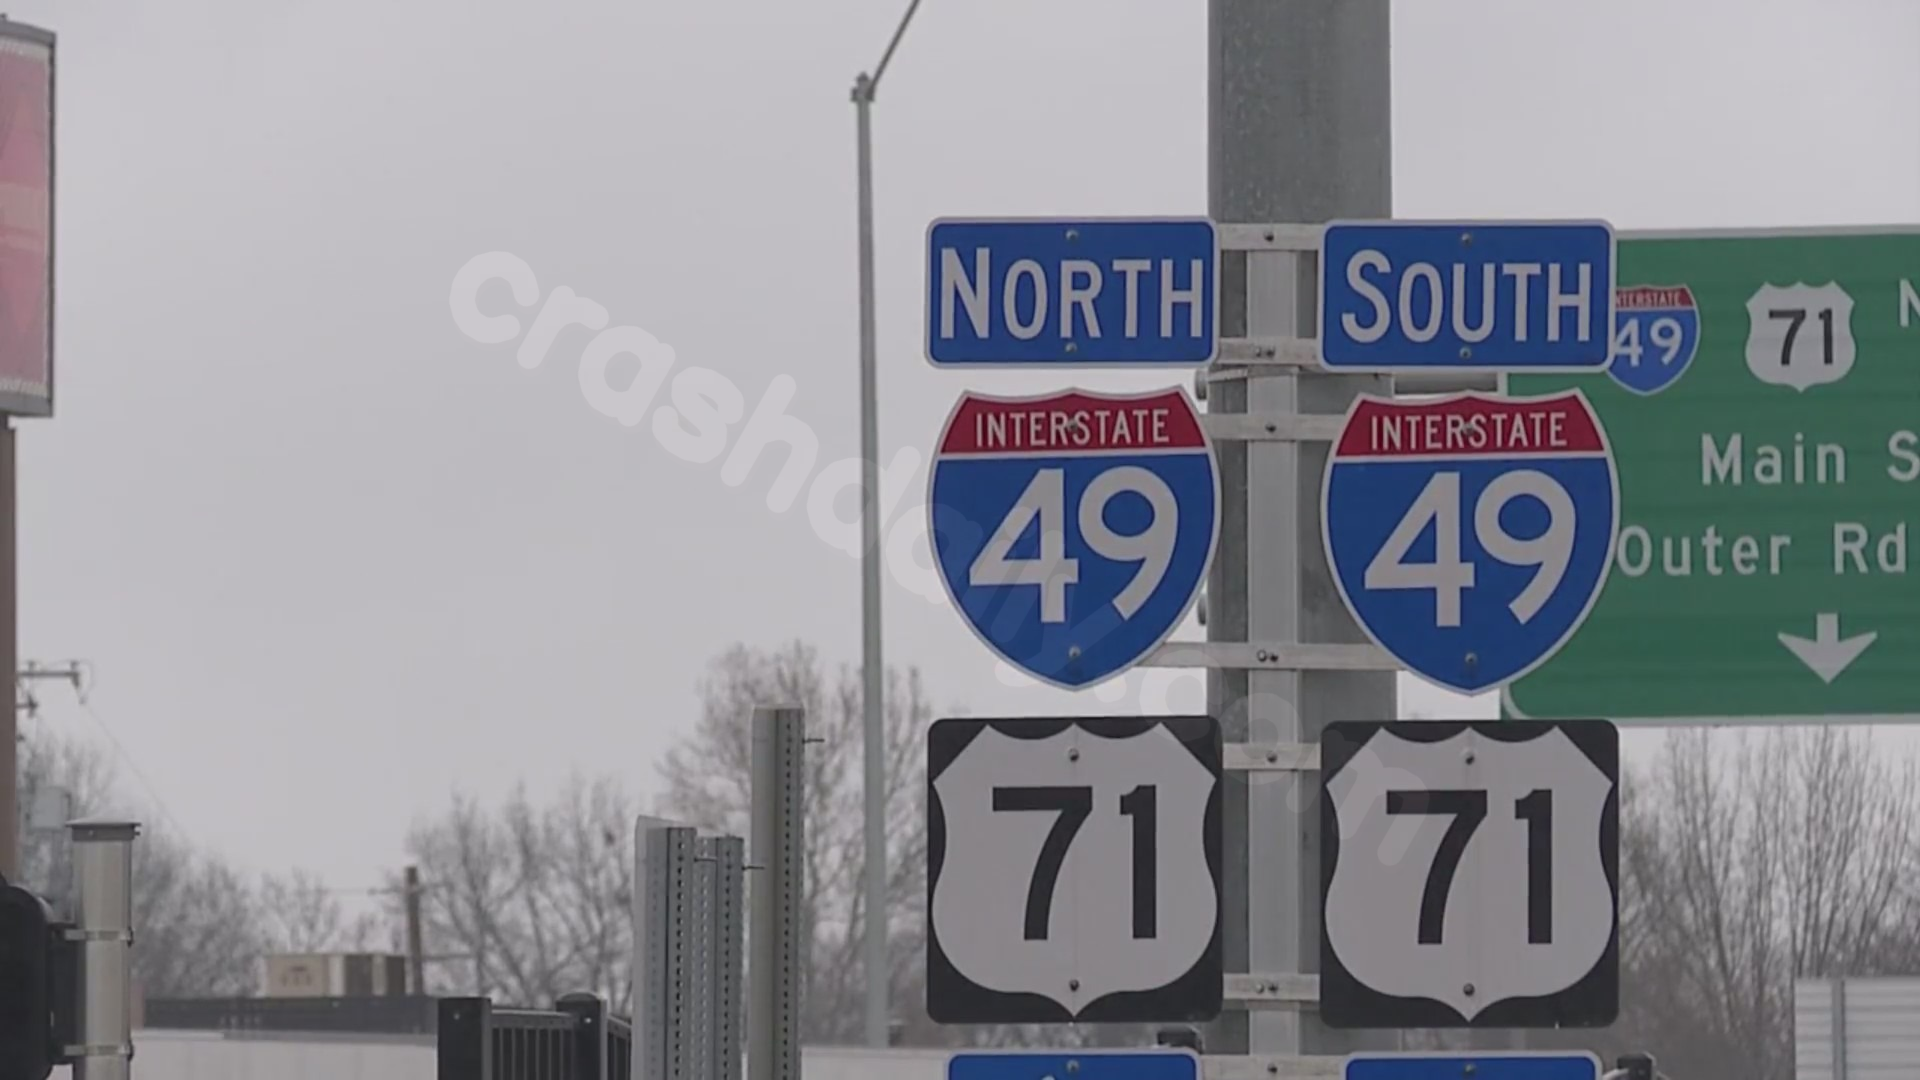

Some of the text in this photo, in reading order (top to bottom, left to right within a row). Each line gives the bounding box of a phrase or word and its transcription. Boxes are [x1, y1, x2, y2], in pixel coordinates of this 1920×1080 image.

[941, 247, 1204, 340] NORTH
[1342, 249, 1592, 343] SOUTH
[1614, 317, 1682, 367] 49
[1768, 308, 1833, 366] 71
[976, 409, 1170, 447] INTERSTATE
[1371, 412, 1567, 450] INTERSTATE
[1701, 432, 1845, 485] Main
[969, 465, 1178, 623] 49
[1364, 469, 1576, 627] 49
[1617, 521, 1906, 577] Outer Rd
[992, 784, 1157, 941] 71
[1385, 788, 1553, 945] 71
